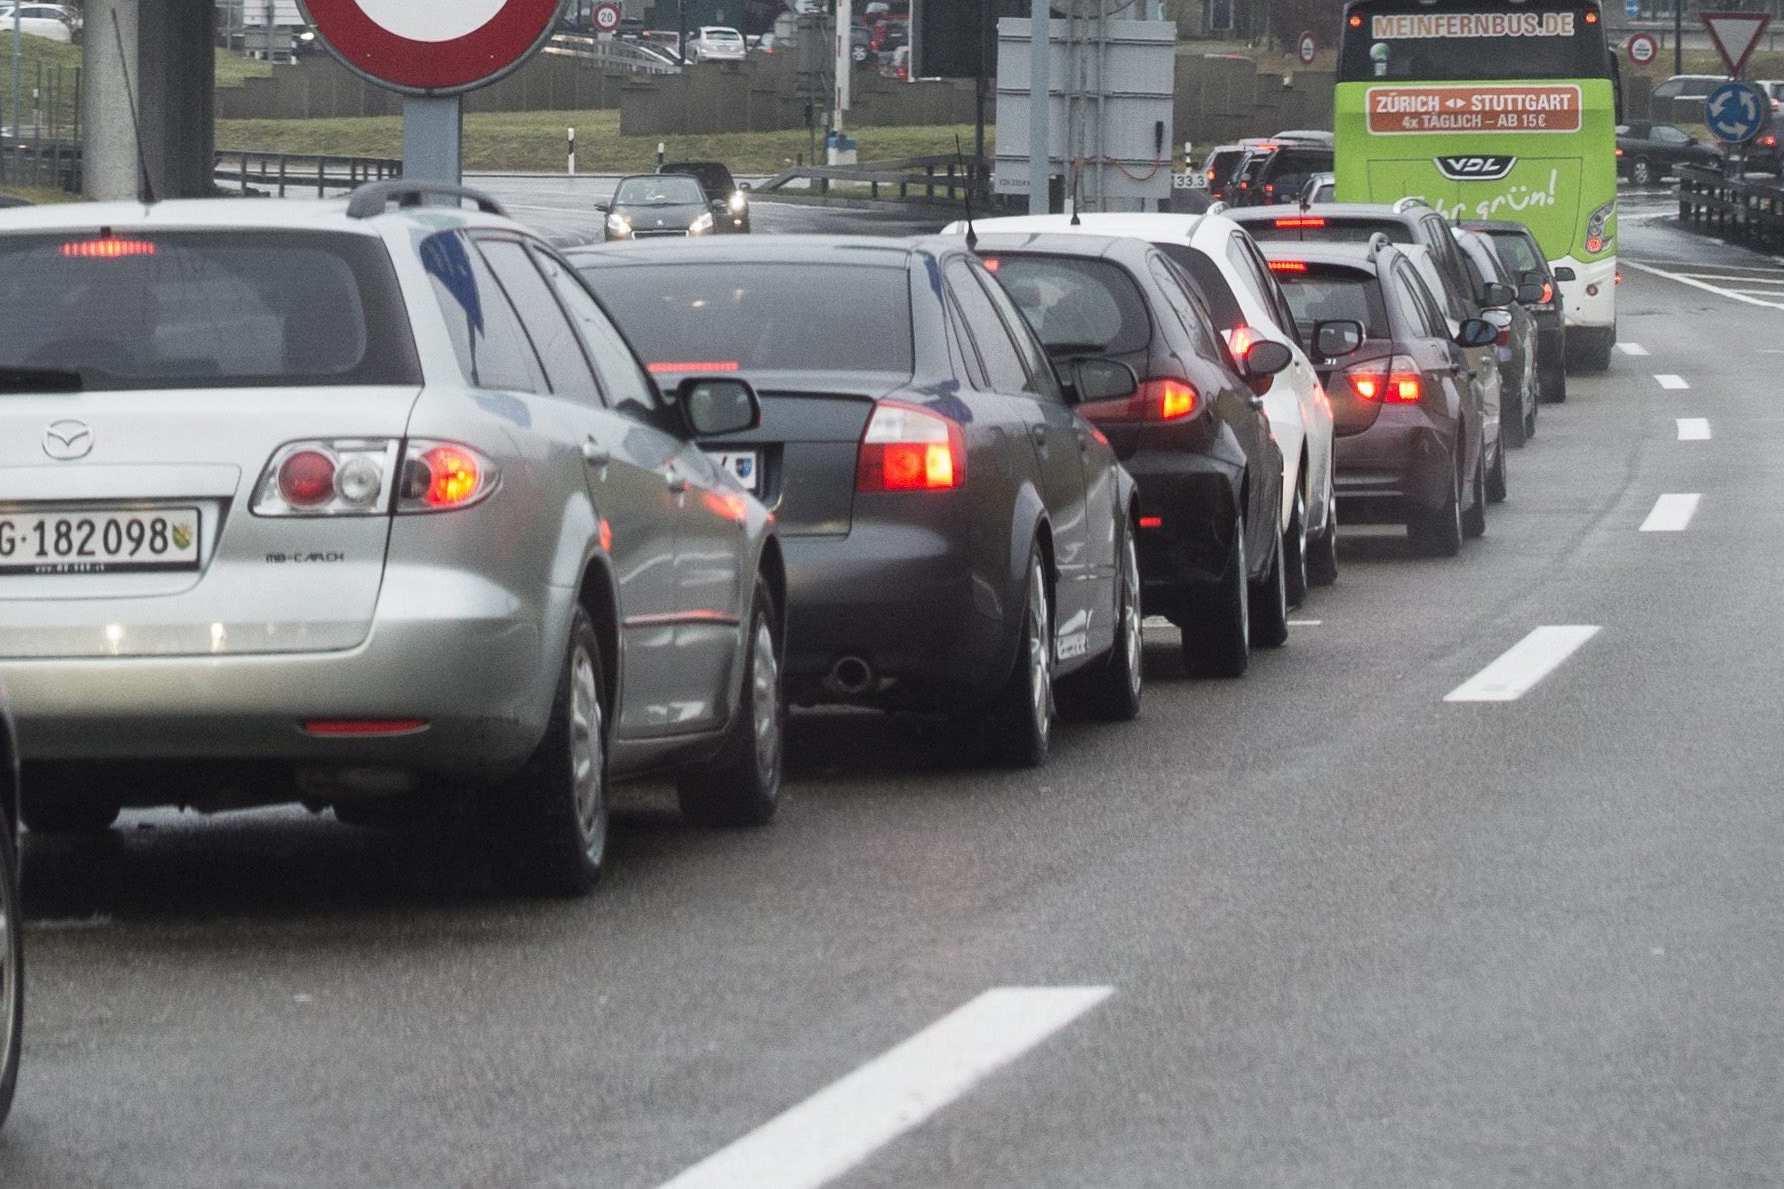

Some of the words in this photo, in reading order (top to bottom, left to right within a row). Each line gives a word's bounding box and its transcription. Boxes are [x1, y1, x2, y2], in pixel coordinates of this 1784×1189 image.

[600, 11, 613, 23] 20
[1372, 12, 1575, 39] MEINFERNBUS.DE
[1376, 92, 1440, 113] ZÜRICH
[1471, 93, 1571, 112] STUTTGART
[1402, 116, 1419, 129] 4x
[1422, 112, 1482, 129] TÄGLICH
[1497, 114, 1518, 127] AB
[1447, 158, 1501, 172] VDL
[1476, 169, 1558, 220] grün!
